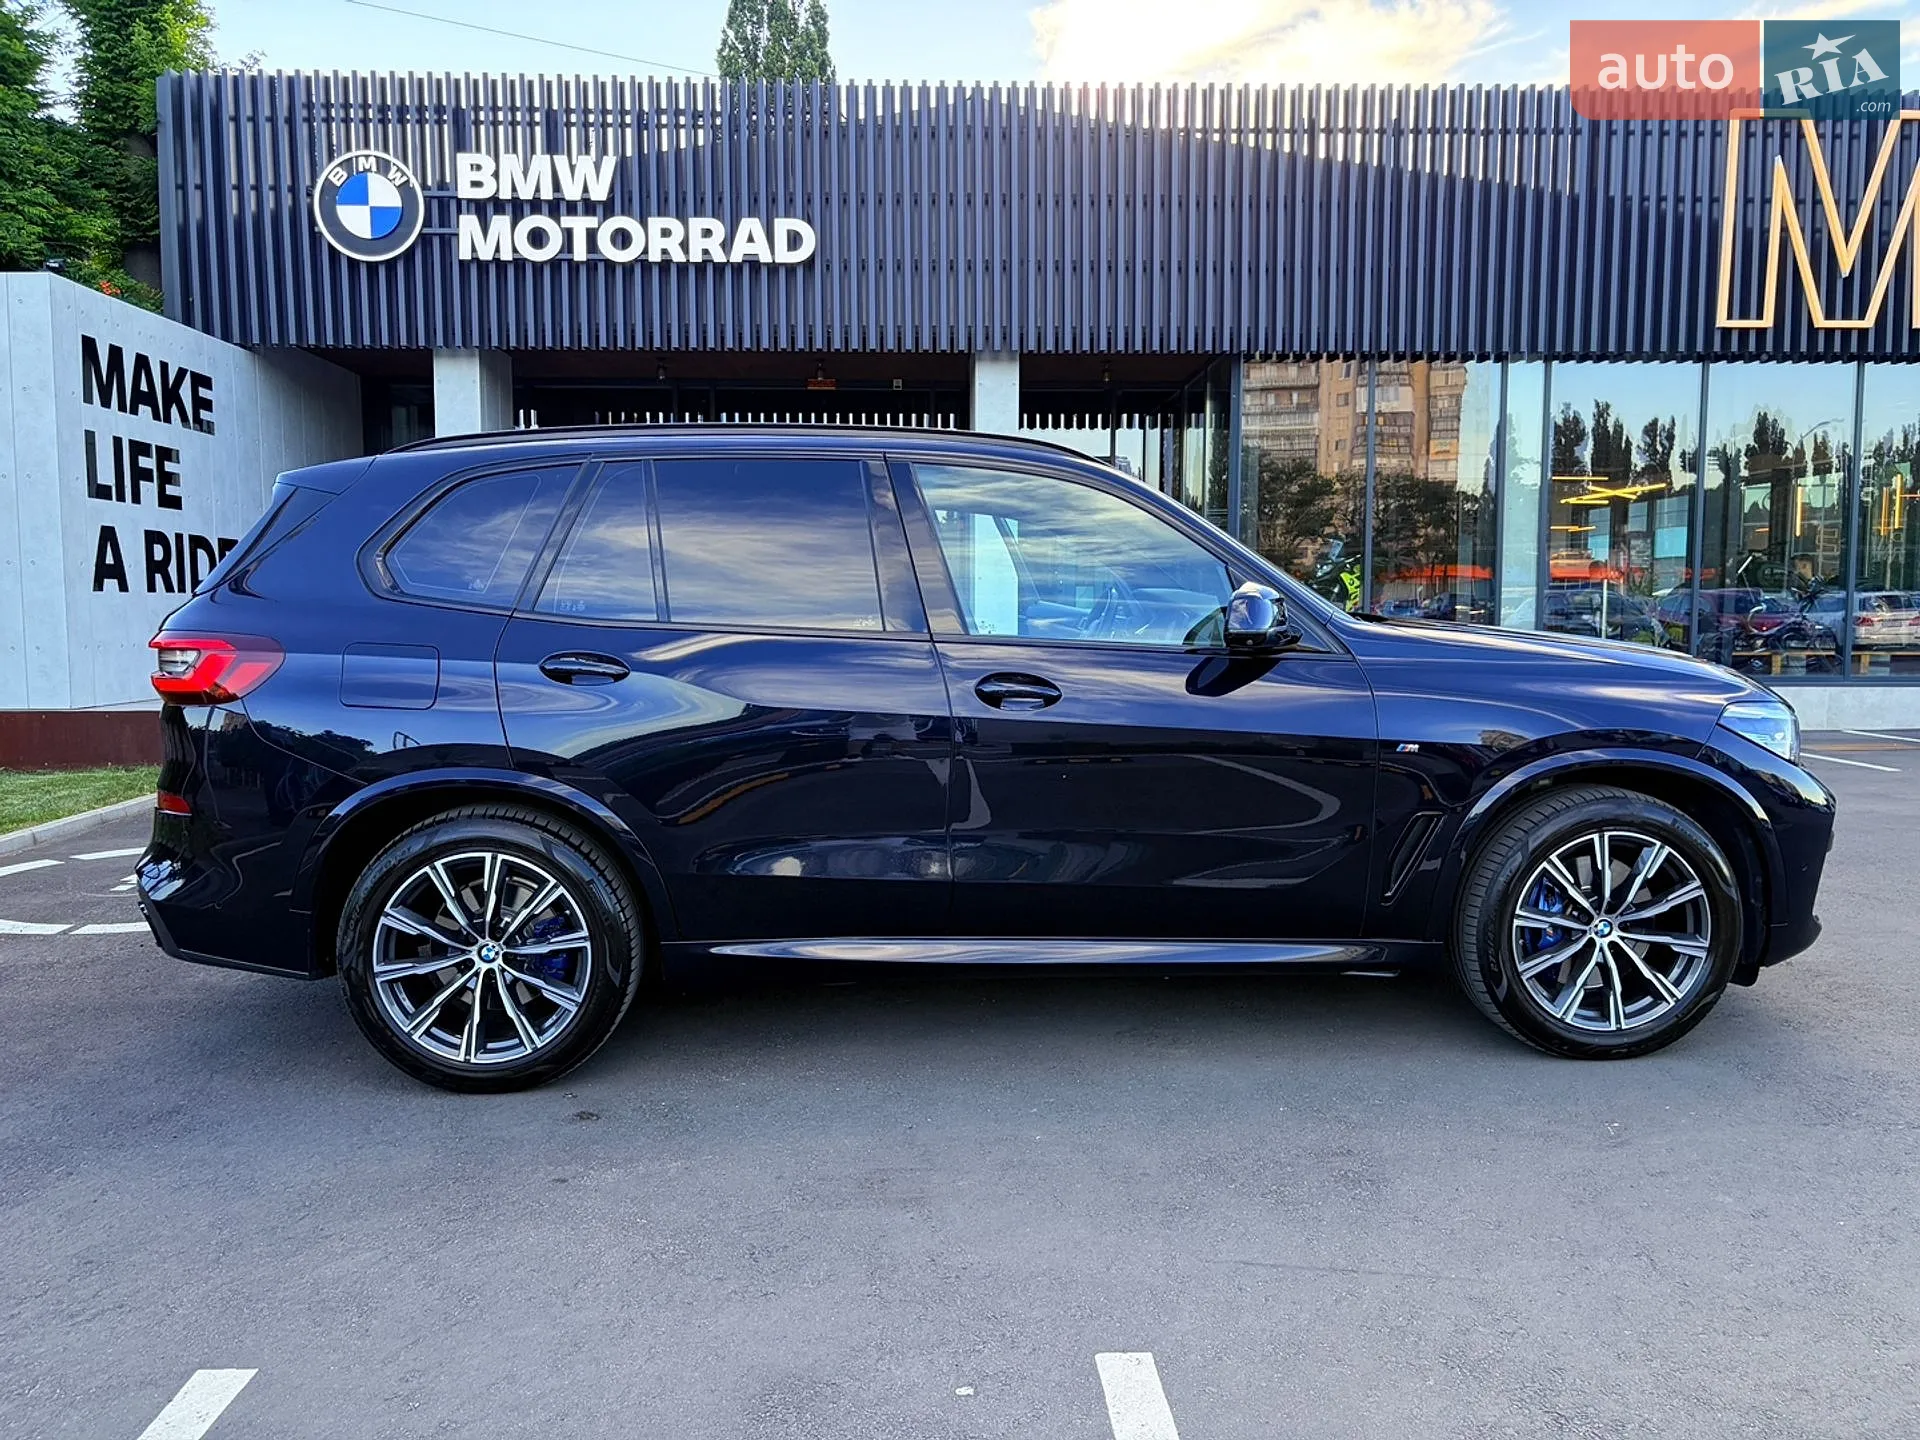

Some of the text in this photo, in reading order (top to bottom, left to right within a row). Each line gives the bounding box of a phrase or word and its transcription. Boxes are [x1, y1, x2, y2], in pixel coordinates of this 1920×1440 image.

[328, 156, 409, 187] BMW
[456, 153, 617, 202] BMW
[459, 215, 816, 264] MOTORRAD
[81, 334, 215, 436] MAKE
[84, 429, 183, 510] LIFE
[92, 525, 129, 593] A
